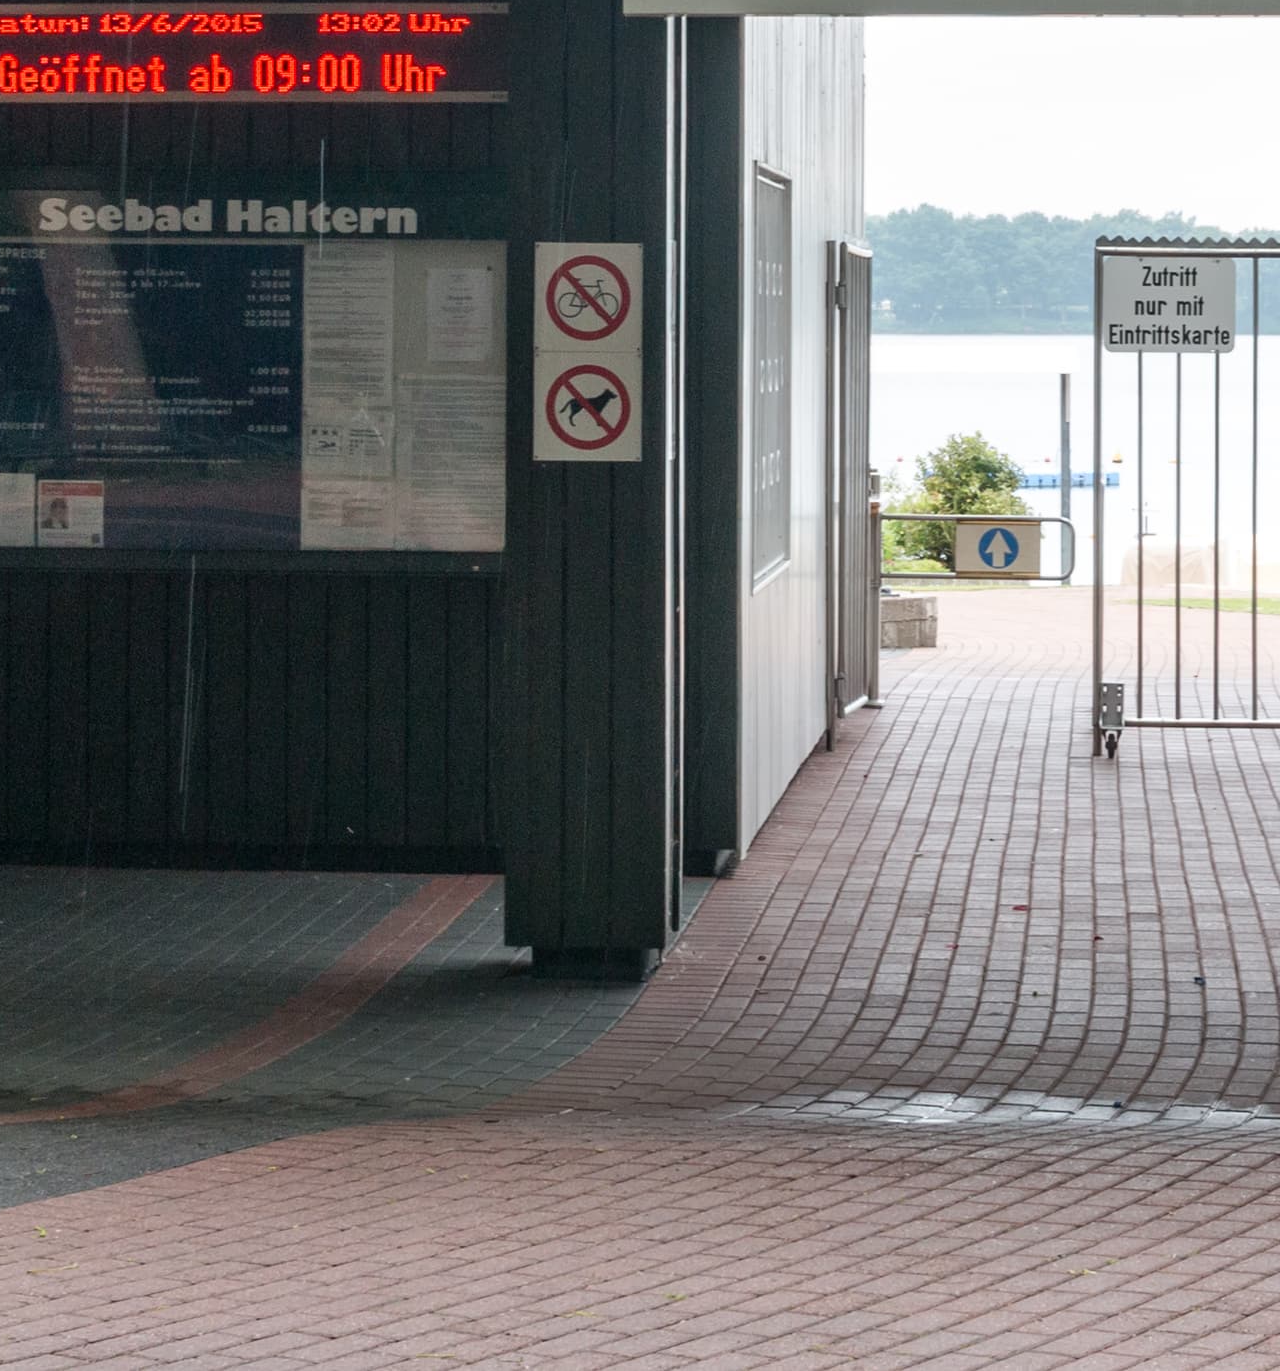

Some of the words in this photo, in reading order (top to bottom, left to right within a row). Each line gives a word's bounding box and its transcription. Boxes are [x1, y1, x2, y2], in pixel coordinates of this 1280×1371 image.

[98, 12, 265, 34] 13/6/2015
[317, 13, 402, 34] 13:02
[407, 13, 471, 33] Uhr
[189, 53, 233, 93] ab
[253, 53, 362, 94] 09:00
[381, 53, 448, 94] Uhr
[38, 197, 213, 233] Seebad
[226, 199, 419, 234] Haltern
[1141, 266, 1198, 287] Zutritt
[1134, 299, 1168, 316] nur
[1176, 295, 1205, 316] mit
[1108, 324, 1231, 346] Eintrittskarte
